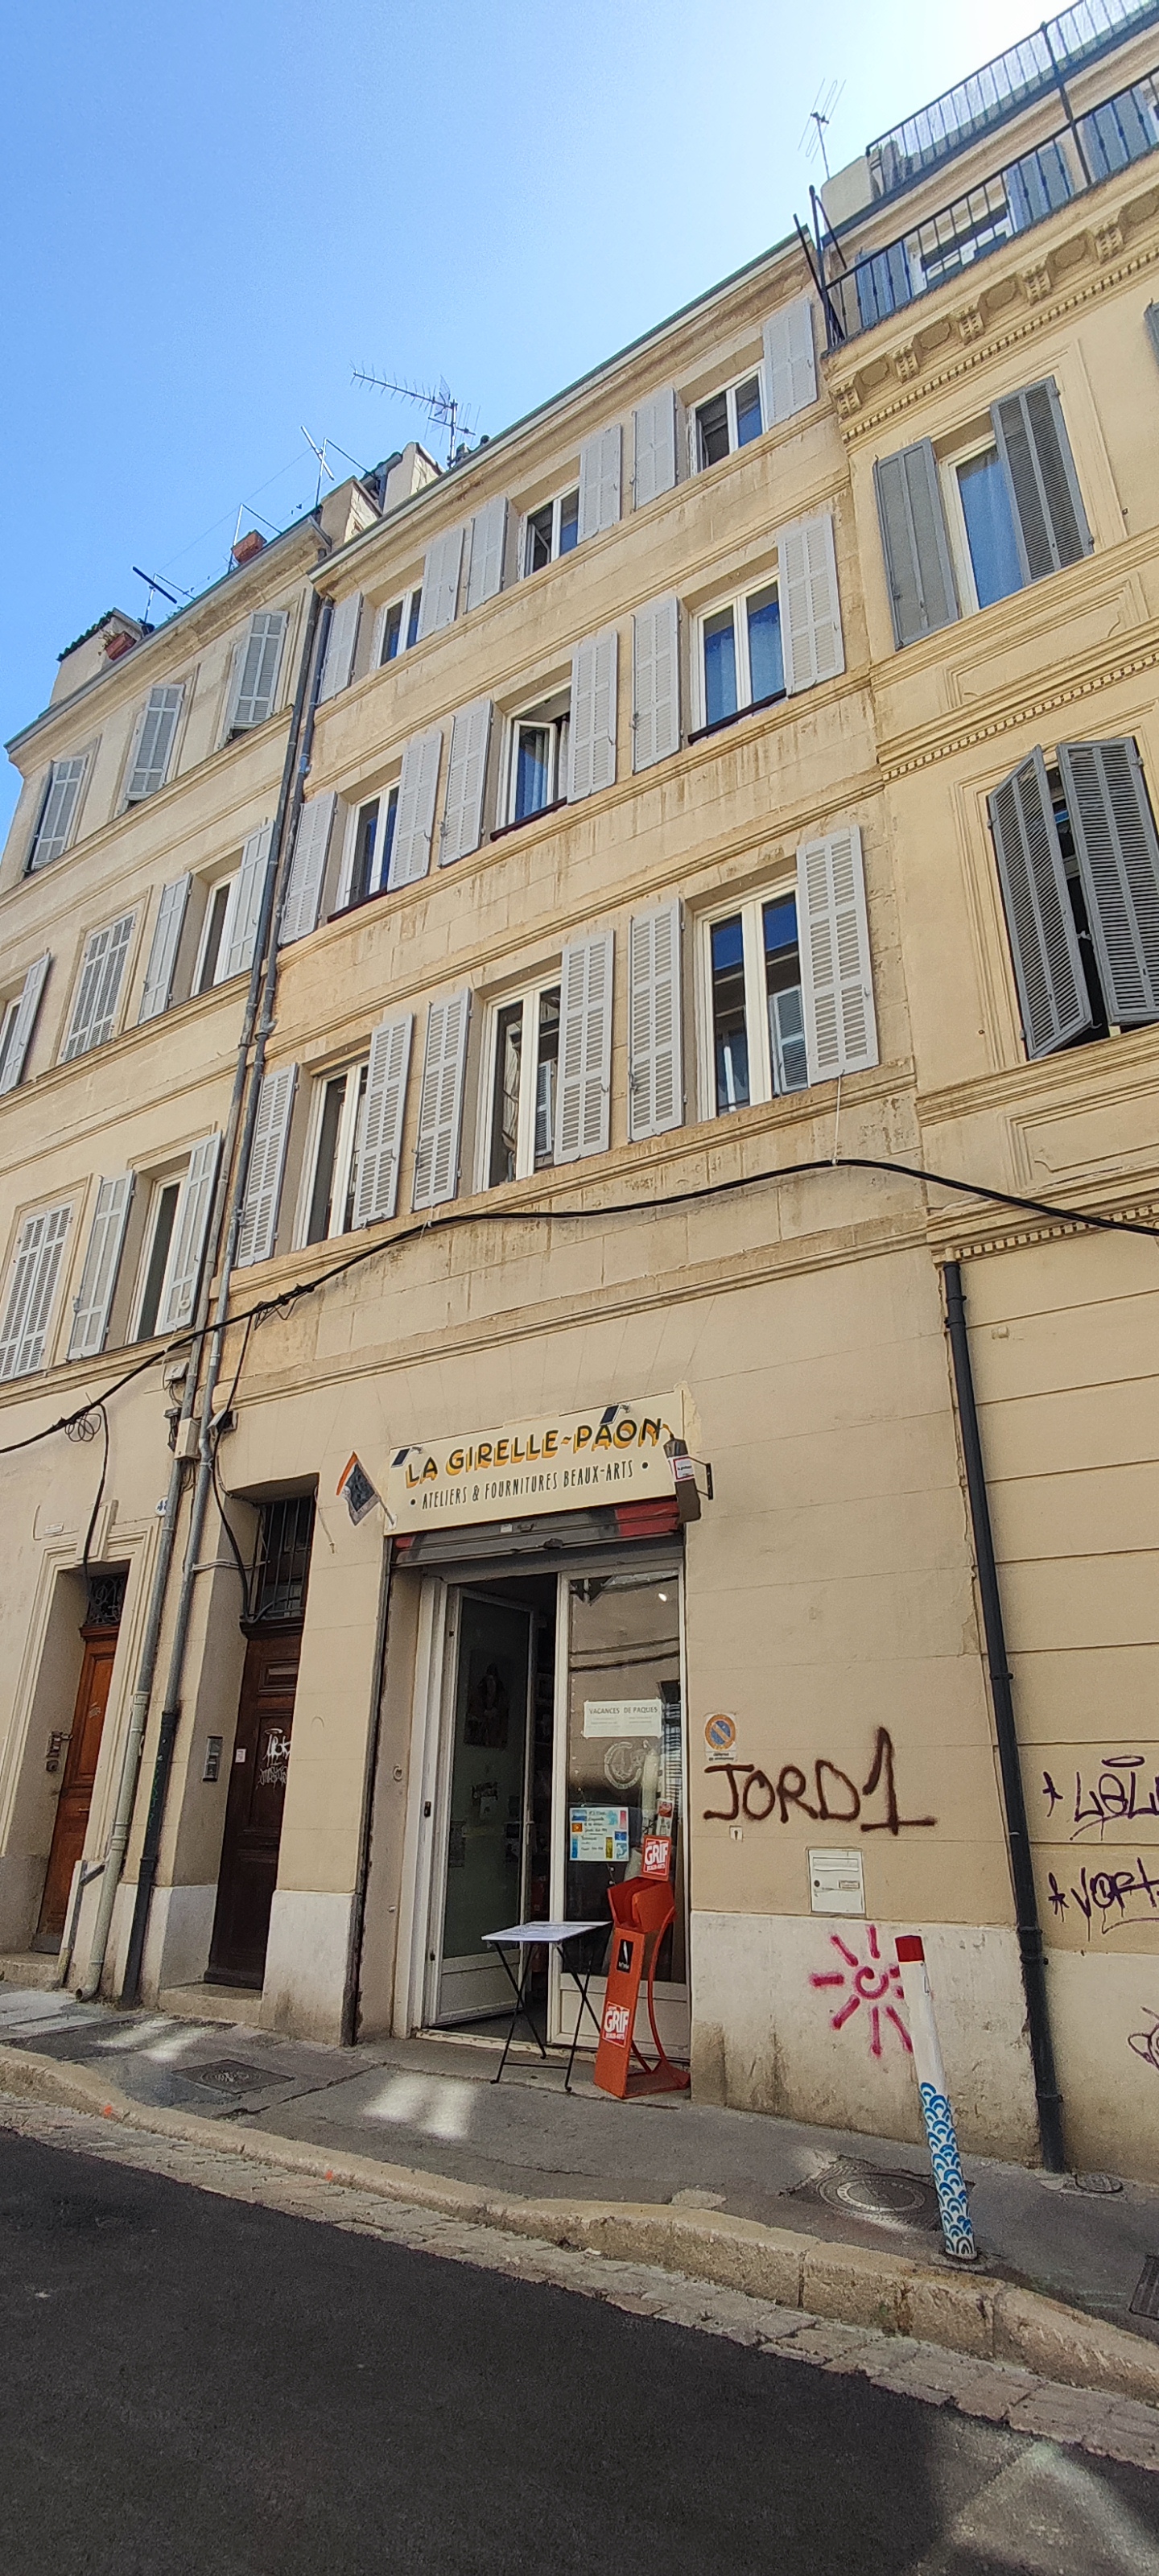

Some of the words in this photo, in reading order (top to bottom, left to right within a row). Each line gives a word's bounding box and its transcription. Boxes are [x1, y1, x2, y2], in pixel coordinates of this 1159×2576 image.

[406, 1456, 439, 1488] LA
[422, 1486, 467, 1509] ATELIERS
[472, 1484, 480, 1501] &
[485, 1472, 557, 1500] FOURNITURES
[563, 1459, 633, 1488] BEAUX-ARTS
[645, 1842, 669, 1865] GRIF
[604, 2010, 630, 2033] GRIF
